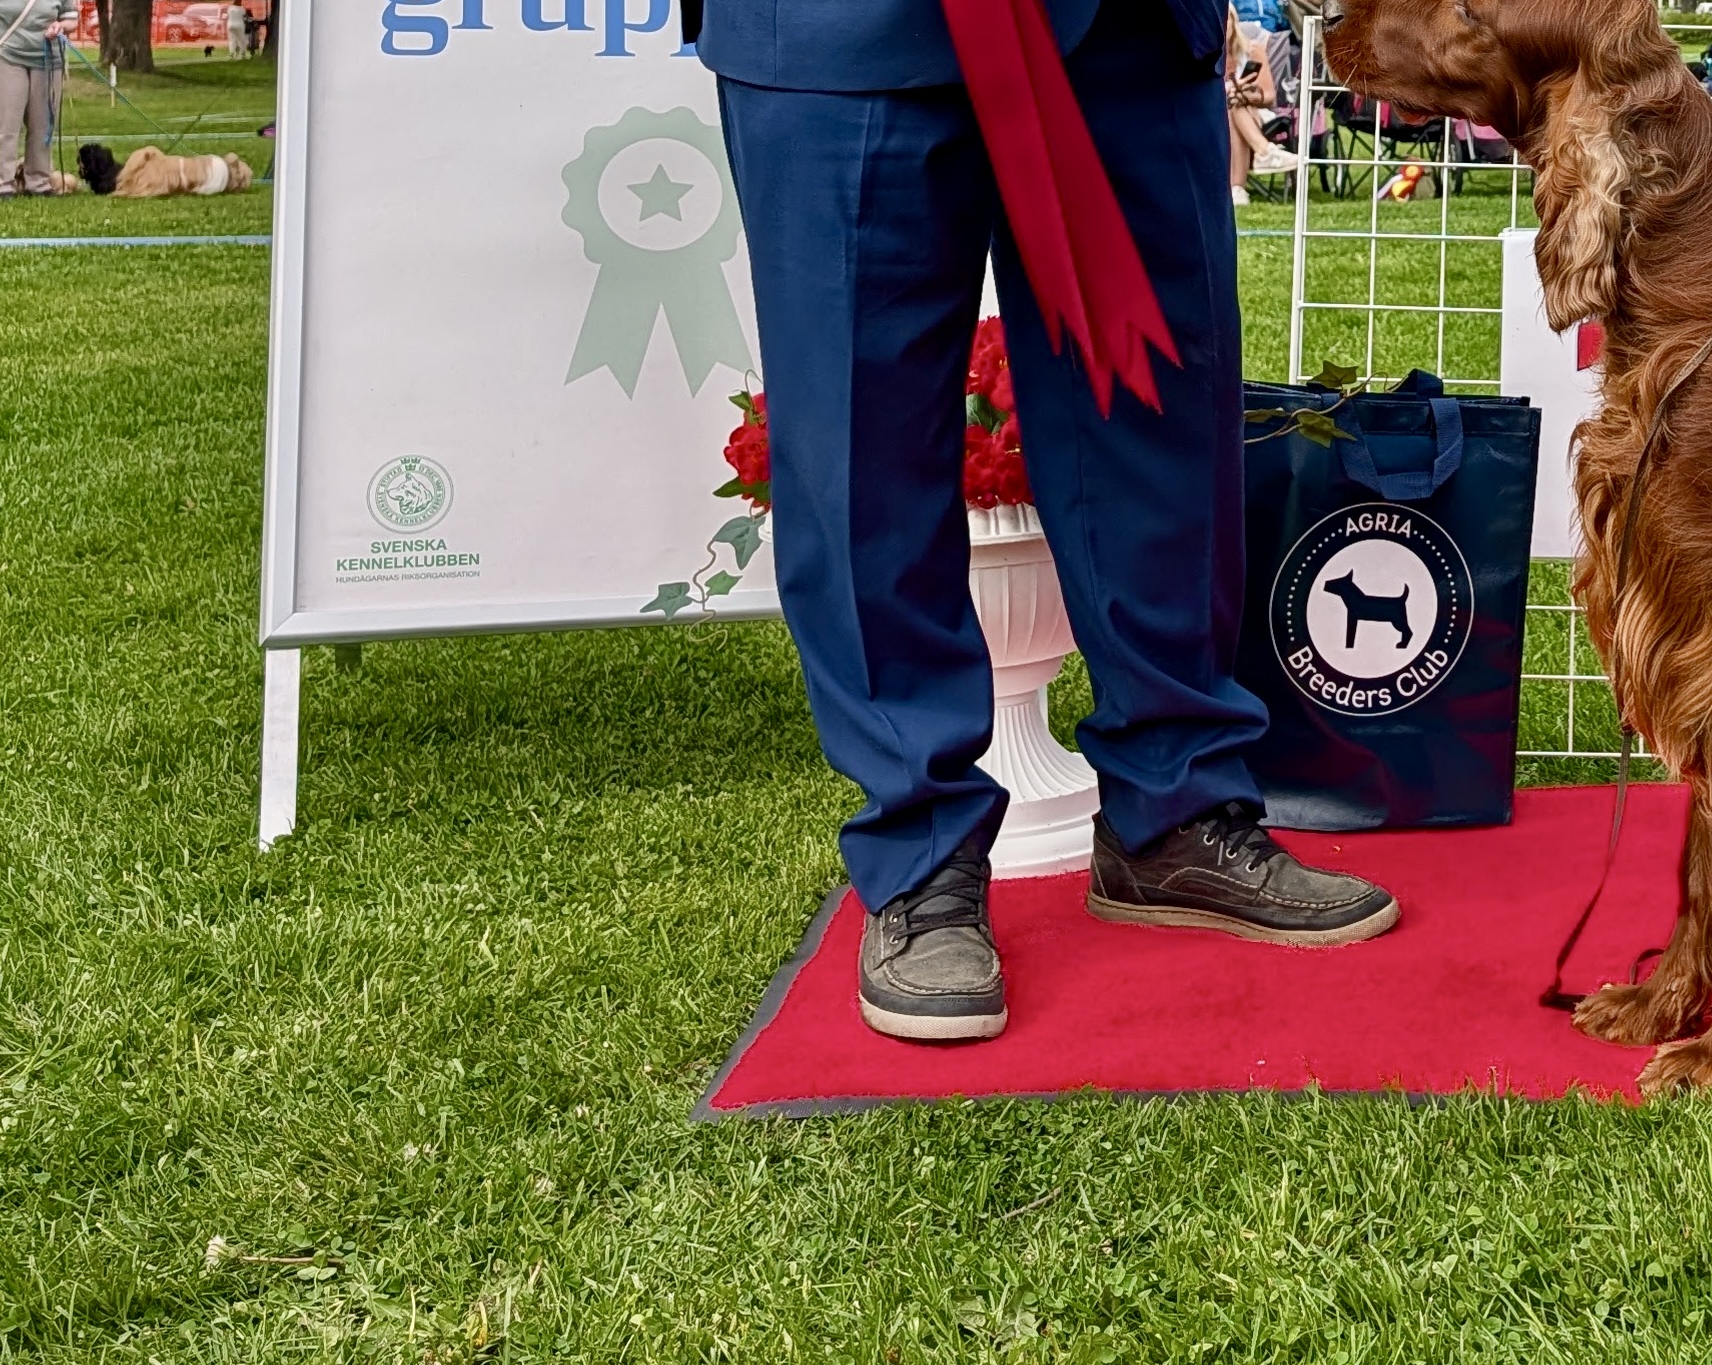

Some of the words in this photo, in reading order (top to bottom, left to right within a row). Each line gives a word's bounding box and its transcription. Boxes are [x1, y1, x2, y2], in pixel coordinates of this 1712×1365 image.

[1345, 512, 1411, 538] AGRIA
[370, 539, 447, 554] SVENSKA
[336, 553, 480, 572] KENNELKLUBBEN
[1288, 645, 1392, 708] Breeders
[1396, 649, 1448, 697] Club
